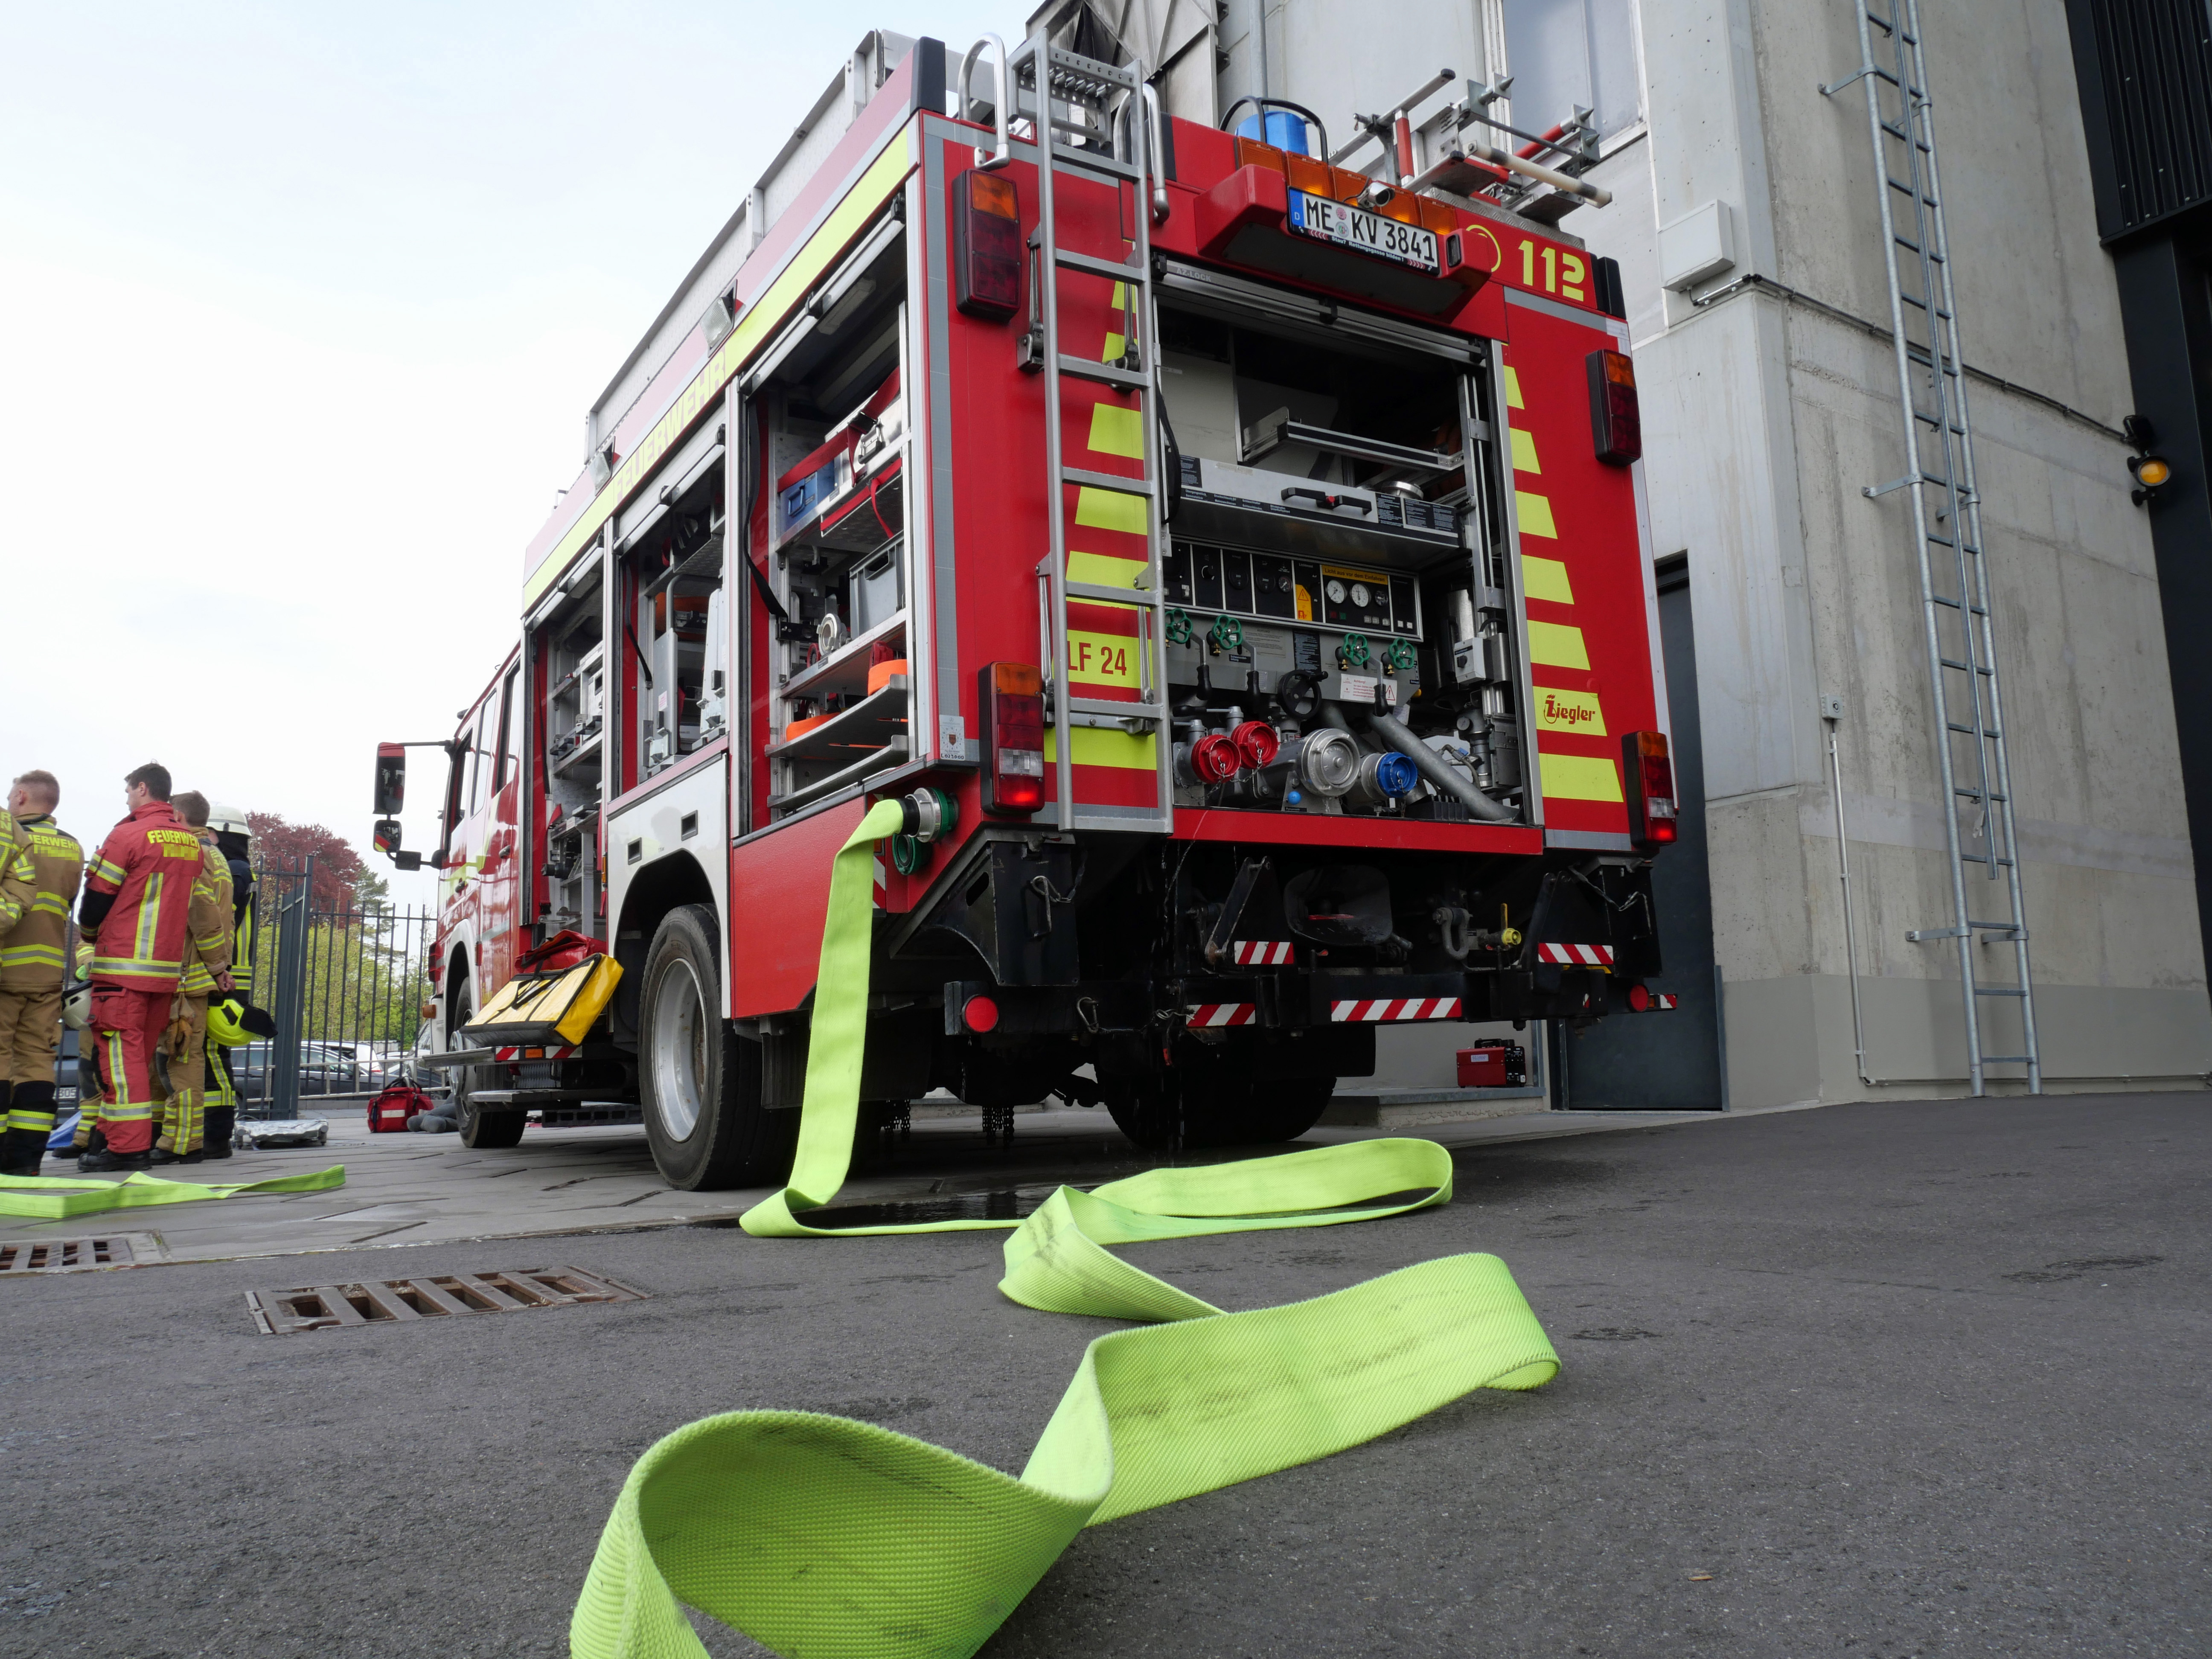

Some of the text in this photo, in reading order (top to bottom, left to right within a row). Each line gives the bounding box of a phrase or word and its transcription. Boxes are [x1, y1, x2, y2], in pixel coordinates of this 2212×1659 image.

[1294, 212, 1300, 221] D
[1305, 198, 1435, 263] ME KV 3841
[1331, 236, 1347, 245] Stau?
[1349, 241, 1385, 256] Rettungsgasse
[1386, 252, 1401, 262] bilden
[1518, 239, 1585, 302] 112
[613, 351, 725, 507] FEUERWEHR
[1100, 646, 1127, 676] 24
[1544, 699, 1595, 725] Ziegler
